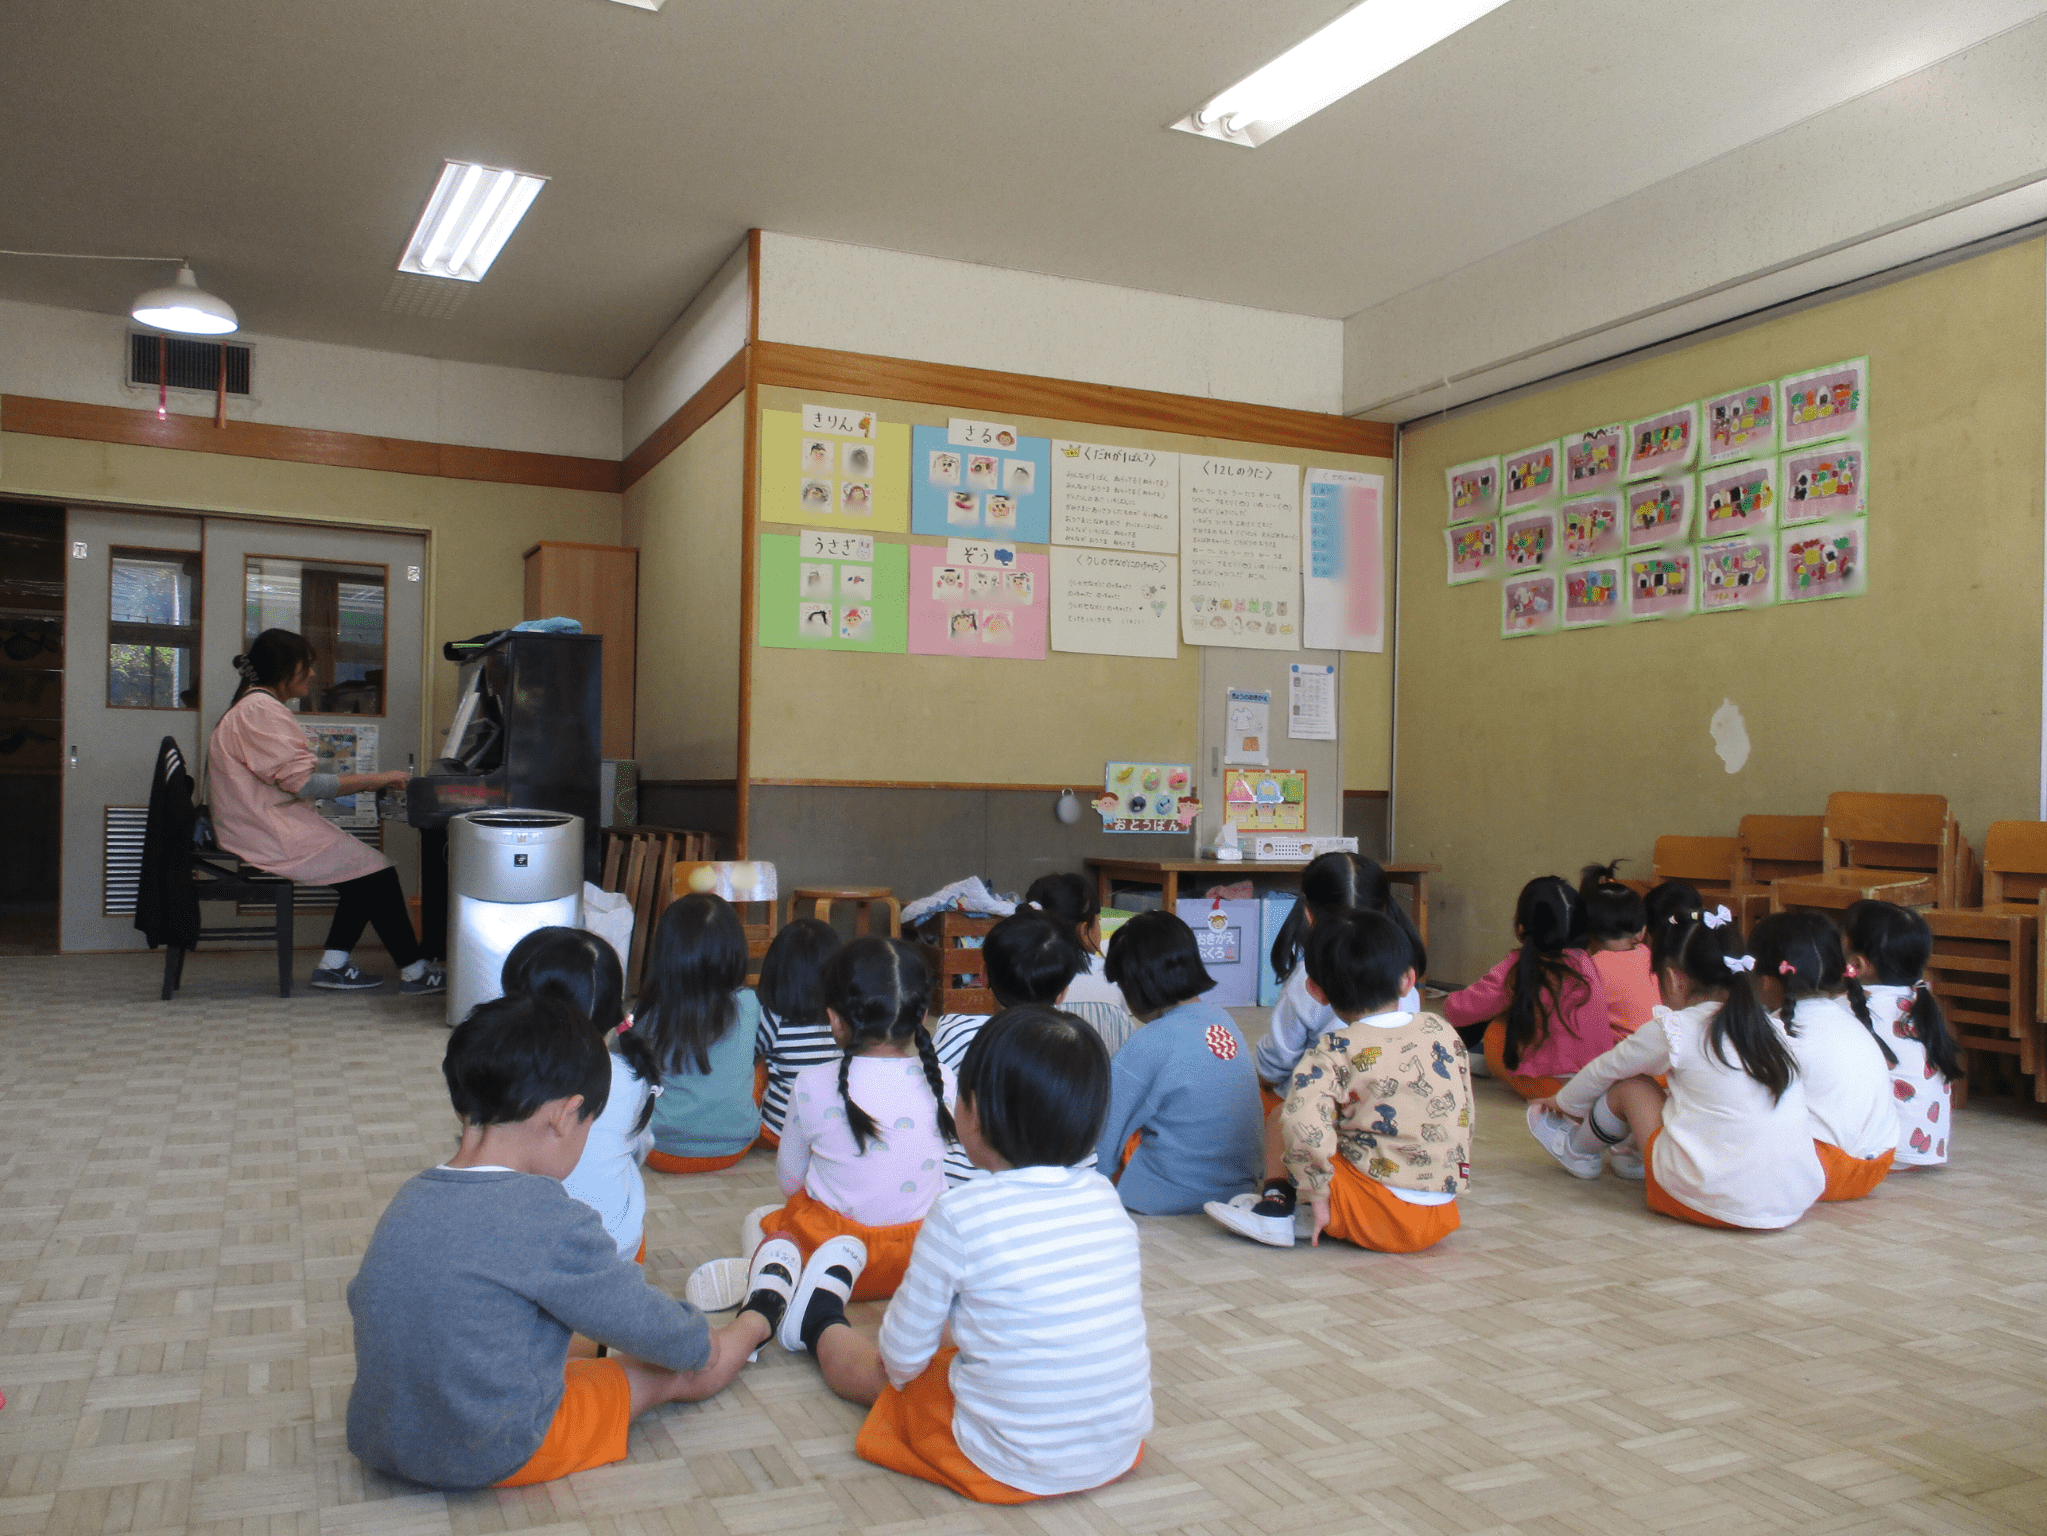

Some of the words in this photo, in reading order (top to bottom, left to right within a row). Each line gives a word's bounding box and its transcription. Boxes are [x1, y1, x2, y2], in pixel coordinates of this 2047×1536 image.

[814, 411, 853, 432] きりん
[965, 425, 992, 443] さる
[815, 537, 856, 557] うさぎ
[964, 546, 989, 564] ぞう
[1114, 818, 1179, 831] おとうばん
[1196, 931, 1236, 946] おきがえ
[344, 967, 360, 980] N
[426, 974, 442, 986] N
